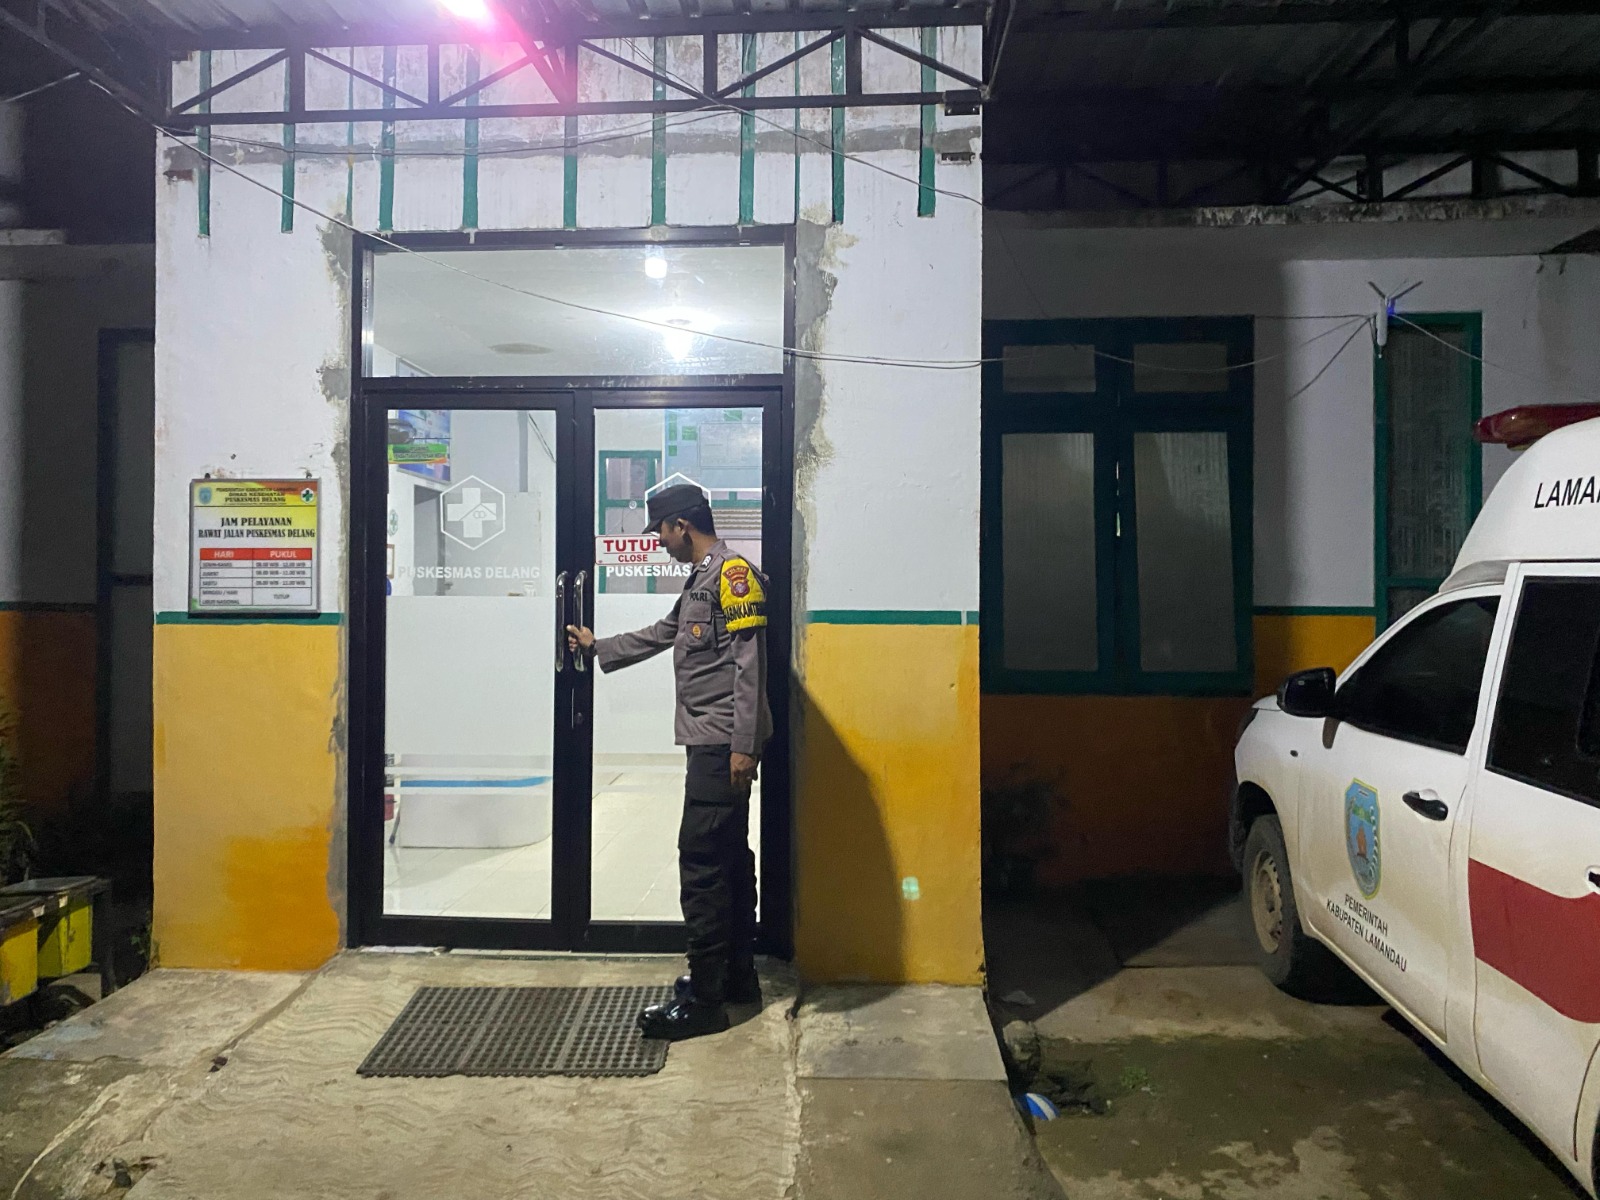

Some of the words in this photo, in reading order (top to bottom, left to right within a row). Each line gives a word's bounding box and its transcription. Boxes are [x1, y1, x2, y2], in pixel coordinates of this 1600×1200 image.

[1534, 476, 1600, 508] LAMA
[221, 517, 238, 527] JAM
[241, 517, 292, 526] PELAYANAN
[198, 529, 221, 538] RAWAT
[223, 529, 244, 539] JALAN
[246, 529, 285, 538] PUSKESMAS
[287, 529, 315, 538] DELANG
[618, 554, 648, 562] CLOSE
[398, 566, 481, 579] PUSKESMAS
[485, 566, 540, 579] DELANG
[606, 565, 691, 577] PUSKESMAS
[1344, 894, 1388, 937] PEMERINTAH
[1327, 899, 1364, 938] KABUPATEN
[1365, 929, 1407, 972] LAMANDAU
